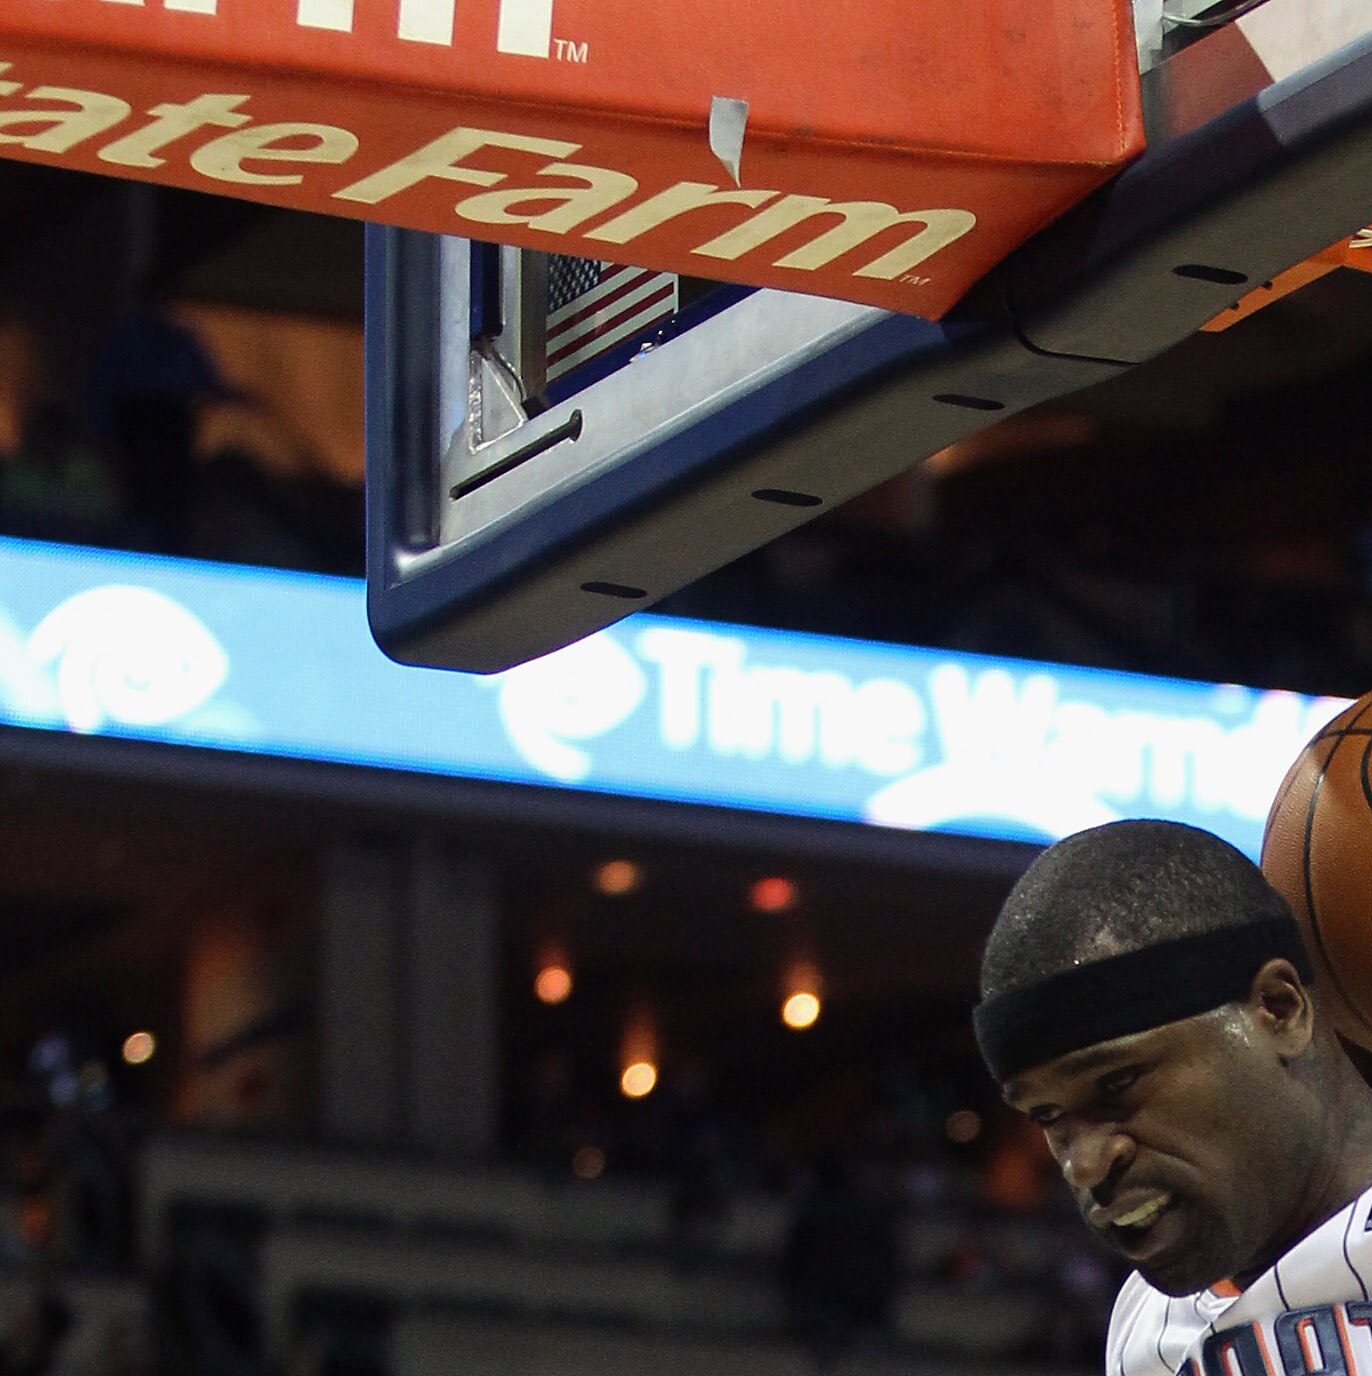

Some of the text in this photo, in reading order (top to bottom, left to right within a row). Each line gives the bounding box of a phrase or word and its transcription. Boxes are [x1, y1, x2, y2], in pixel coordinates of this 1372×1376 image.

[553, 39, 589, 64] TM
[331, 126, 978, 281] Farm
[637, 626, 926, 776] Time
